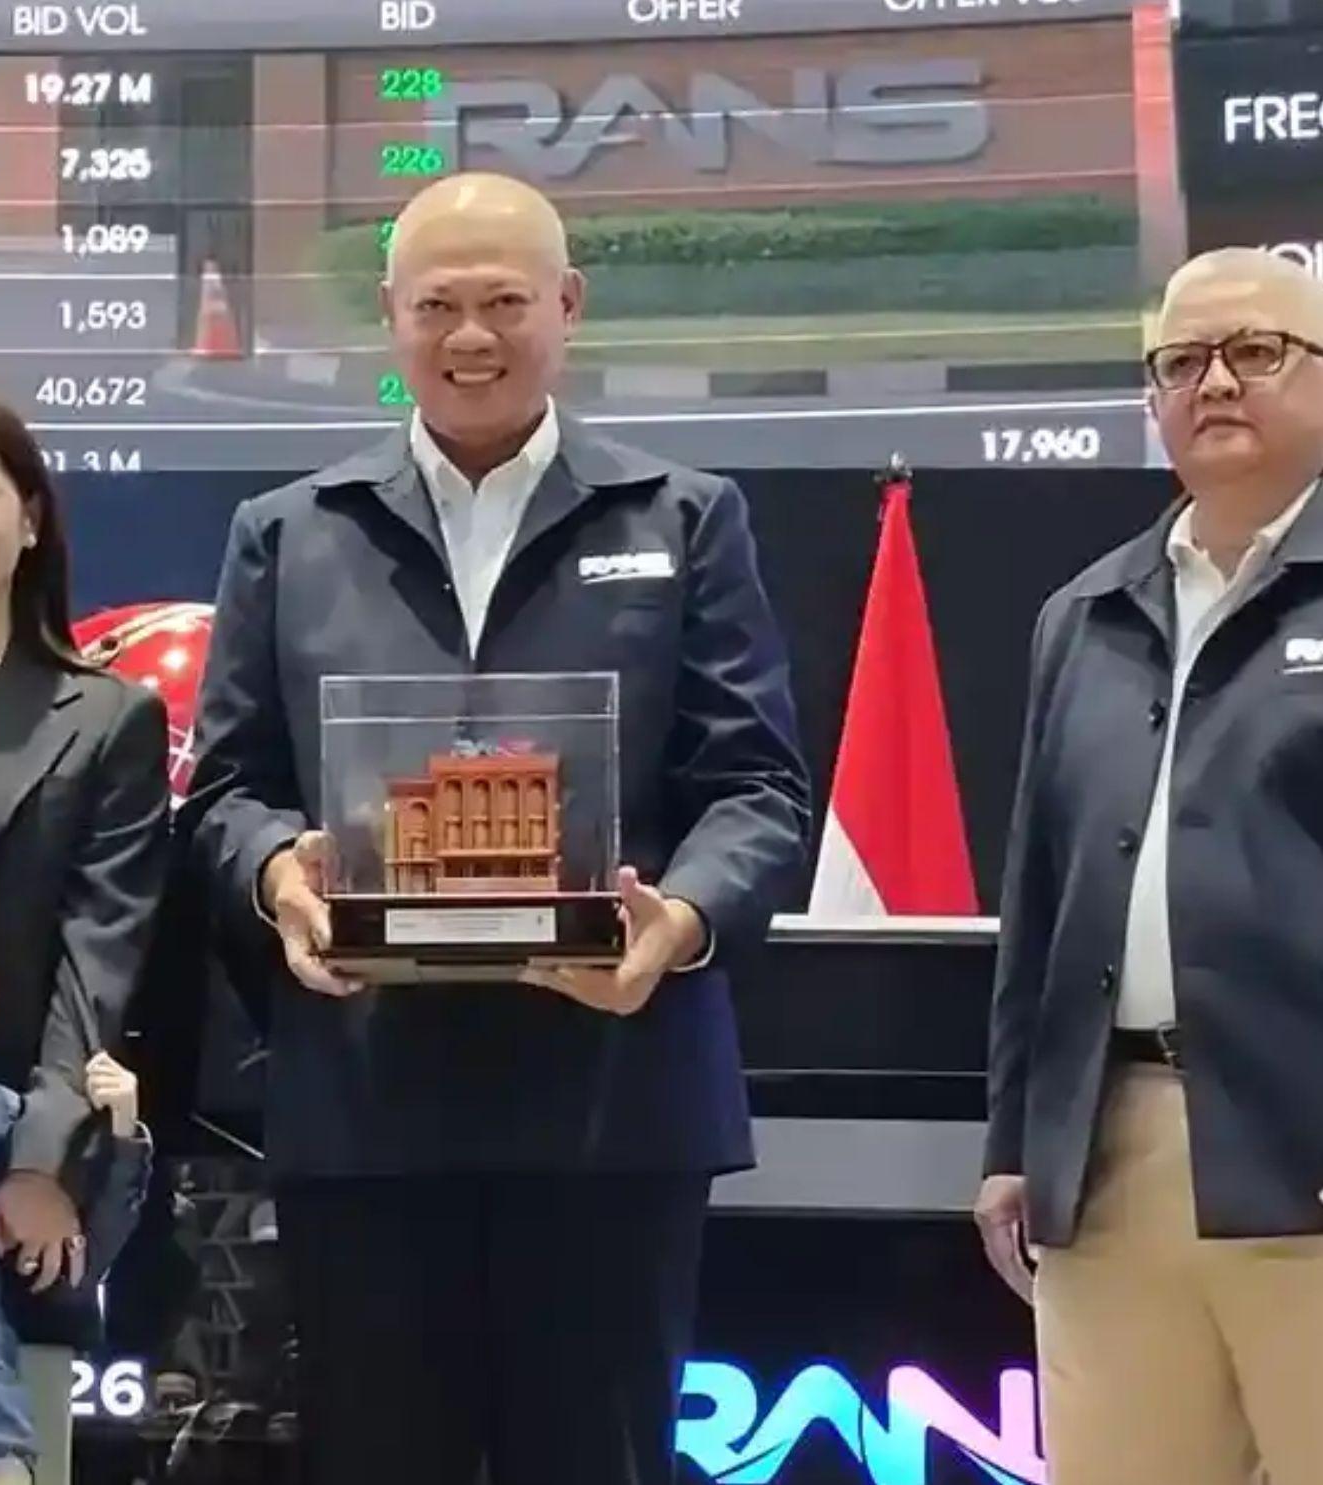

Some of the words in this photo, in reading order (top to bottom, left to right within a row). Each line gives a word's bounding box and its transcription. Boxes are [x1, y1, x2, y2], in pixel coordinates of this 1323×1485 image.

[13, 6, 68, 35] BID
[76, 5, 147, 36] VOL
[381, 0, 436, 31] BID
[627, 0, 742, 22] OFFER
[25, 73, 112, 105] 19.27
[119, 73, 152, 103] M
[382, 69, 443, 98] 228
[429, 58, 989, 179] RANS
[1224, 92, 1323, 143] FRE
[61, 148, 152, 182] 7,325
[382, 146, 443, 174] 226
[62, 224, 149, 258] 1,089
[61, 301, 147, 333] 1,593
[36, 377, 146, 409] 40,672
[982, 427, 1100, 463] 17,960
[675, 1361, 1045, 1485] RAN
